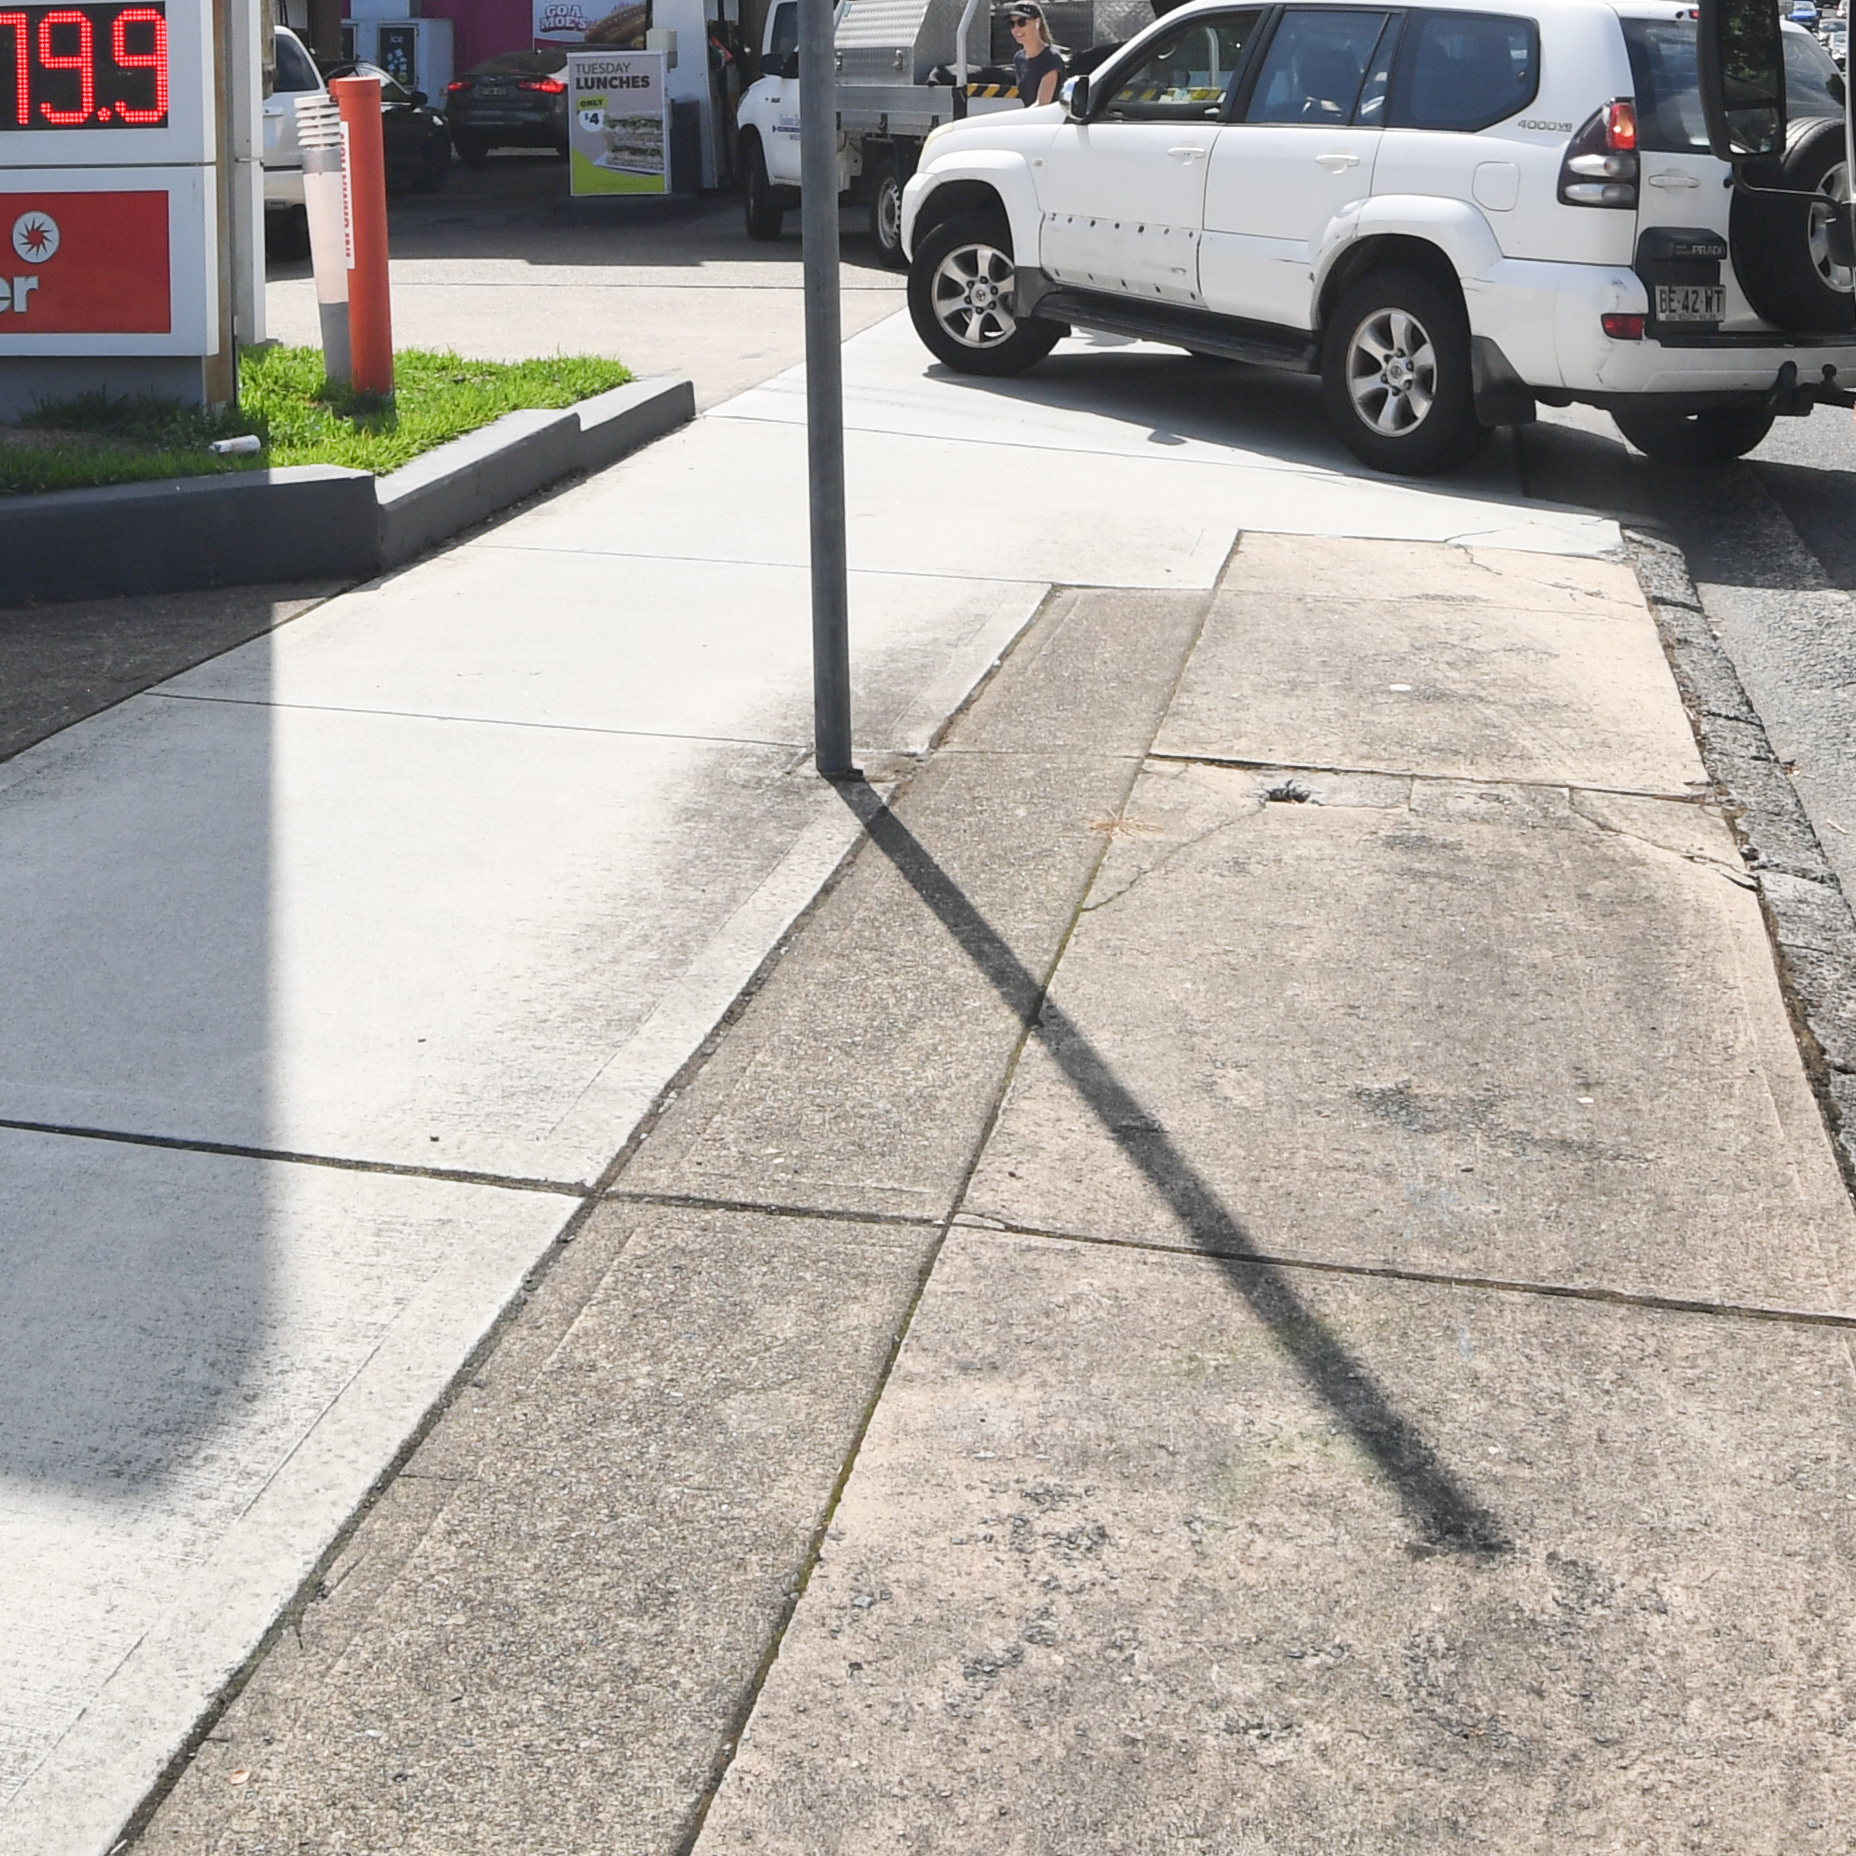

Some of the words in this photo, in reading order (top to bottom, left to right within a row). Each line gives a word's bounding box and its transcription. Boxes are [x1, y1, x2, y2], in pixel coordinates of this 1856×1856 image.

[546, 5, 567, 17] GO
[569, 5, 582, 17] A
[540, 16, 588, 29] MOE'S
[576, 62, 630, 75] TUESDAY
[576, 75, 650, 90] LUNCHES
[581, 99, 604, 107] ONLY
[585, 113, 599, 125] $4
